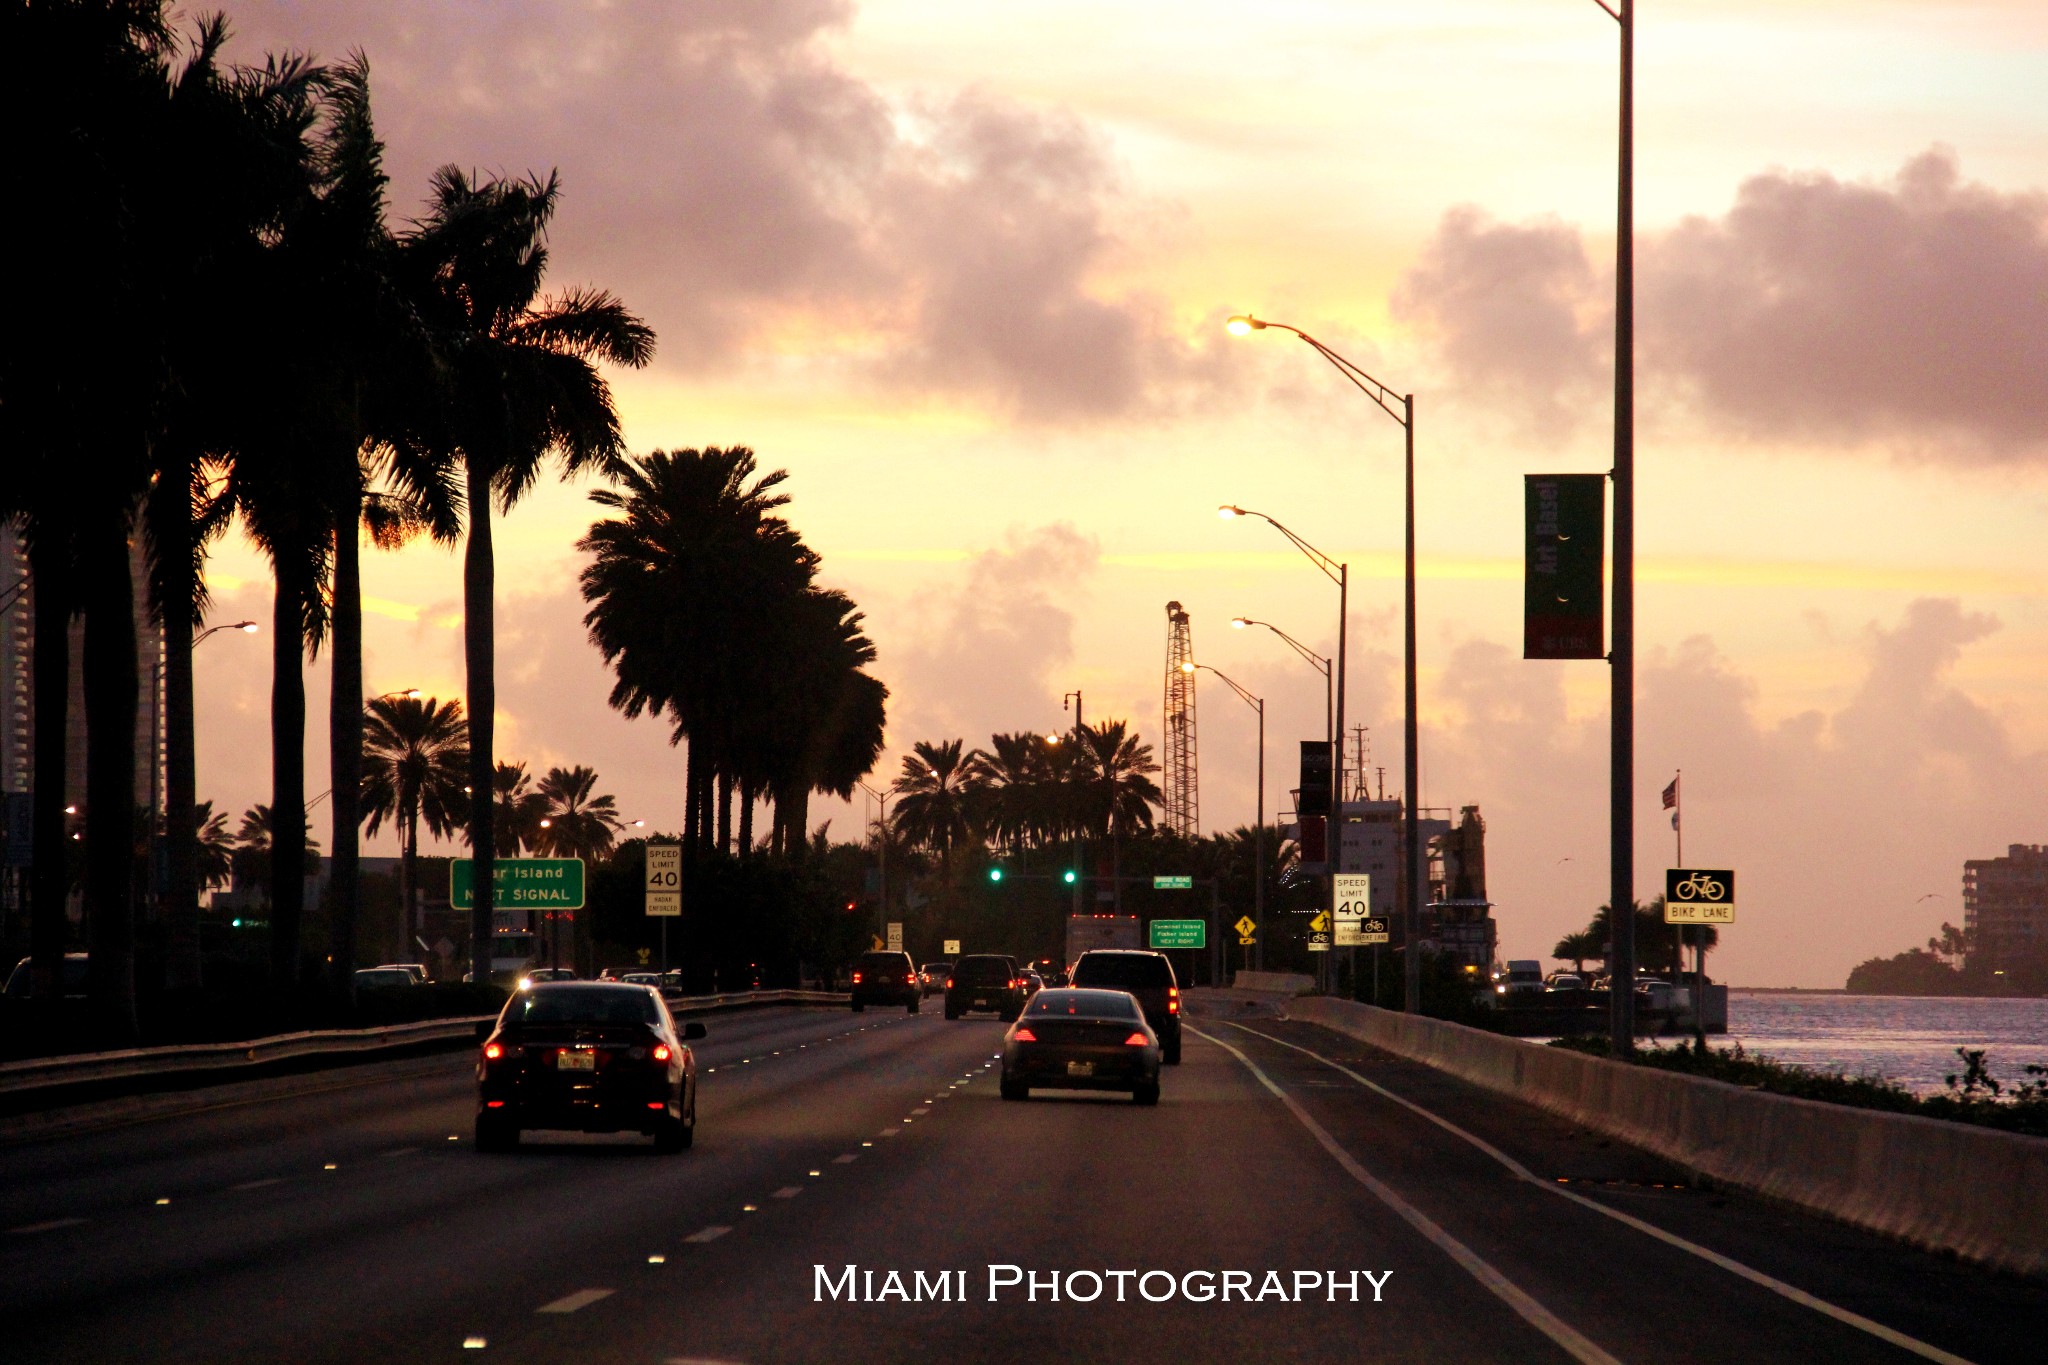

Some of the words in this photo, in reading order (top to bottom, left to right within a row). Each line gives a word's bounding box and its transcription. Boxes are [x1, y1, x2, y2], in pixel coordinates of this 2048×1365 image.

[649, 850, 679, 858] SPEED
[652, 861, 674, 869] LIMIT
[515, 867, 563, 879] Island
[649, 871, 678, 887] 40
[1337, 879, 1367, 887] SPEED
[464, 889, 505, 901] NT
[513, 889, 571, 901] SIGNAL
[1338, 901, 1366, 916] 40
[1671, 906, 1695, 918] BIKE
[1703, 907, 1729, 918] LANE
[889, 933, 900, 941] 40
